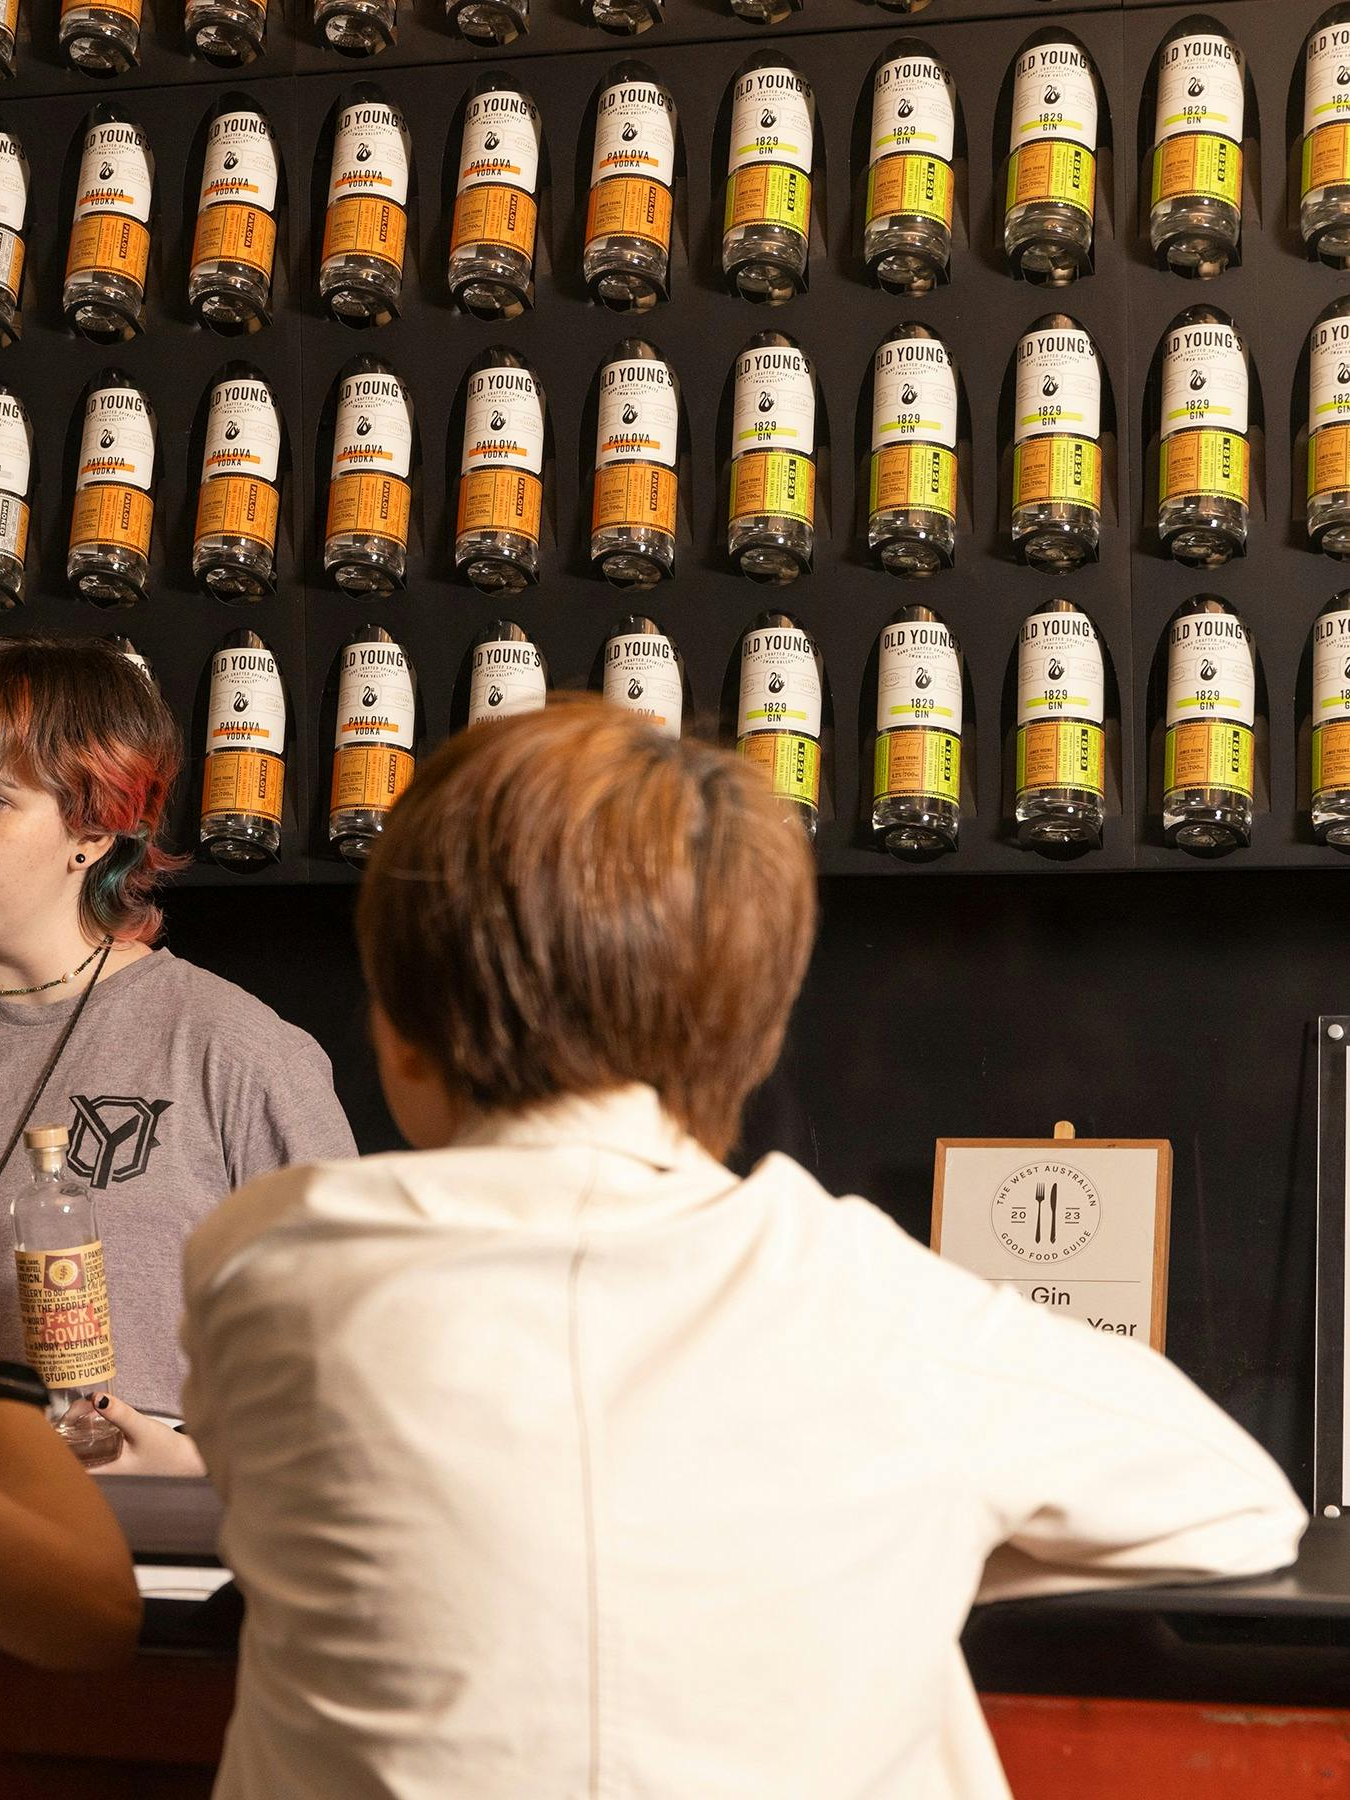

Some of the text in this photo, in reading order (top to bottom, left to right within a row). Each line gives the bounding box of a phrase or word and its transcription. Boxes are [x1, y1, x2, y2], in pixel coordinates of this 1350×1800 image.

[1184, 106, 1206, 116] 1829
[1040, 113, 1062, 122] 1829
[894, 126, 915, 137] 1829
[756, 136, 778, 146] 1829
[897, 137, 910, 145] GIN
[607, 150, 649, 162] PAVLOVA
[470, 158, 510, 171] PAVLOVA
[614, 160, 639, 168] VODKA
[342, 170, 382, 181] PAVLOVA
[477, 169, 501, 177] VODKA
[210, 177, 248, 190] PAVLOVA
[348, 180, 373, 188] VODKA
[85, 188, 123, 199] PAVLOVA
[216, 188, 239, 196] VODKA
[91, 198, 114, 206] VODKA
[1186, 399, 1209, 410] 1829
[1038, 406, 1061, 416] 1829
[1190, 411, 1203, 419] GIN
[898, 414, 920, 424] 1829
[1042, 418, 1056, 426] GIN
[754, 421, 776, 432] 1829
[901, 425, 914, 433] GIN
[609, 433, 649, 445] PAVLOVA
[758, 432, 771, 441] GIN
[343, 444, 382, 456] PAVLOVA
[476, 440, 517, 451] PAVLOVA
[616, 444, 640, 453] VODKA
[212, 448, 250, 460] PAVLOVA
[349, 455, 373, 463] VODKA
[483, 450, 508, 458] VODKA
[87, 456, 124, 468] PAVLOVA
[218, 459, 241, 467] VODKA
[92, 467, 115, 475] VODKA
[1172, 624, 1189, 644] OLD
[1316, 622, 1332, 641] OLD
[885, 631, 905, 649] OLD
[745, 638, 760, 657] OLD
[1044, 690, 1067, 700] 1829
[1196, 690, 1219, 700] 1829
[764, 702, 786, 712] 1829
[911, 698, 934, 709] 1829
[1049, 702, 1062, 710] GIN
[1200, 702, 1214, 710] GIN
[768, 714, 781, 722] GIN
[915, 710, 928, 718] GIN
[220, 721, 259, 731] PAVLOVA
[349, 716, 388, 726] PAVLOVA
[226, 732, 250, 740] VODKA
[355, 727, 380, 735] VODKA
[997, 1165, 1097, 1207] THE WEST AUSTRALIAN
[1011, 1211, 1080, 1220] 20 23
[1001, 1230, 1091, 1260] GOOD FOOD GUIDE
[1031, 1287, 1070, 1305] Gin
[38, 1301, 89, 1312] THE PEOPLE,
[1087, 1318, 1137, 1336] Year
[64, 1337, 97, 1350] DEFIANT
[45, 1371, 76, 1383] STUPID
[78, 1362, 111, 1379] FUCKING
